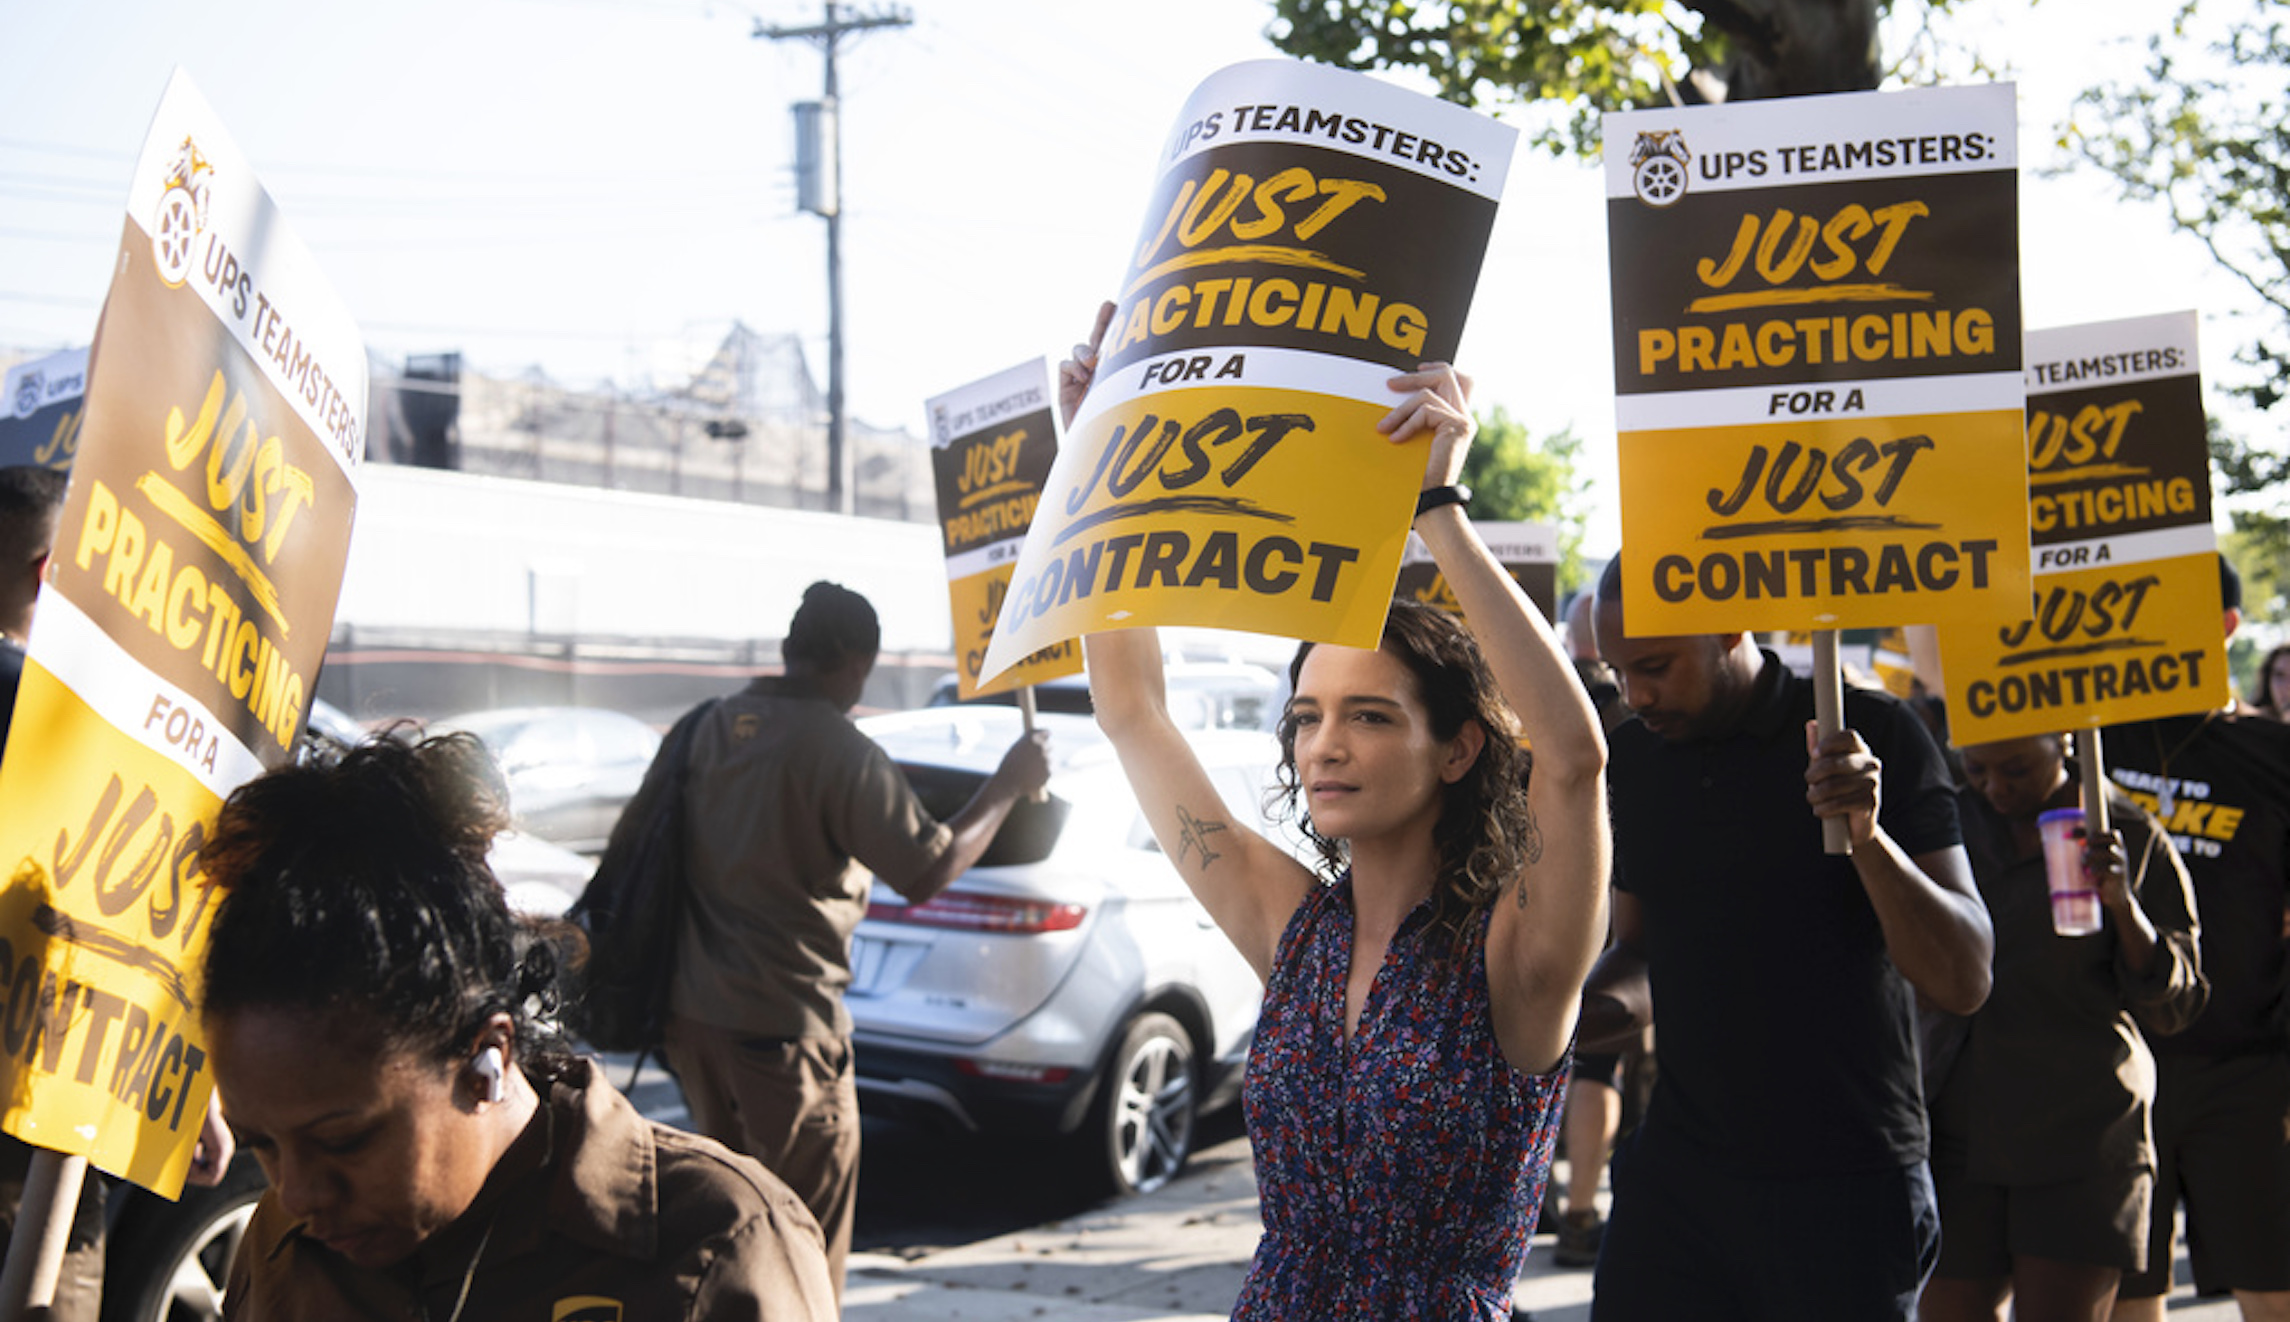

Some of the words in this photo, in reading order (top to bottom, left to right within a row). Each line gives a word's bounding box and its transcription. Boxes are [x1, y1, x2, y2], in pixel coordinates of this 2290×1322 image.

[1171, 112, 1223, 161] UPS
[1233, 105, 1481, 182] TEAMSTERS:
[1700, 150, 1768, 181] UPS
[1778, 132, 1996, 174] TEAMSTERS:
[1137, 167, 1388, 268] JUST
[1696, 200, 1930, 289] JUST
[204, 232, 251, 321] UPS
[252, 291, 360, 467] TEAMSTERS:
[1106, 277, 1429, 358] RACTICING
[1638, 308, 1996, 375] PRACTICING
[1139, 355, 1212, 389] FOR
[1215, 354, 1246, 379] A
[2034, 348, 2186, 385] TEAMSTERS:
[1768, 391, 1834, 418] FOR
[1842, 389, 1865, 413] A
[2028, 399, 2144, 470] UST
[166, 368, 315, 565] JUST
[957, 429, 1028, 494] JUST
[1065, 407, 1316, 516] JUST
[1705, 434, 1935, 518] JUST
[945, 491, 1041, 547] PRACTICI
[2029, 477, 2196, 532] CTICING
[1008, 531, 1361, 636] CONTRACT
[1652, 540, 1998, 603] CONTRACT
[2040, 545, 2089, 568] FOR
[2095, 543, 2112, 561] A
[75, 479, 303, 752] PRACTICING
[979, 577, 1010, 624] JU
[2000, 575, 2161, 648] JUST
[1967, 650, 2205, 719] CONTRACT
[144, 693, 209, 764] FOR
[201, 736, 219, 775] A
[2182, 780, 2211, 799] TO
[2193, 838, 2222, 858] TO
